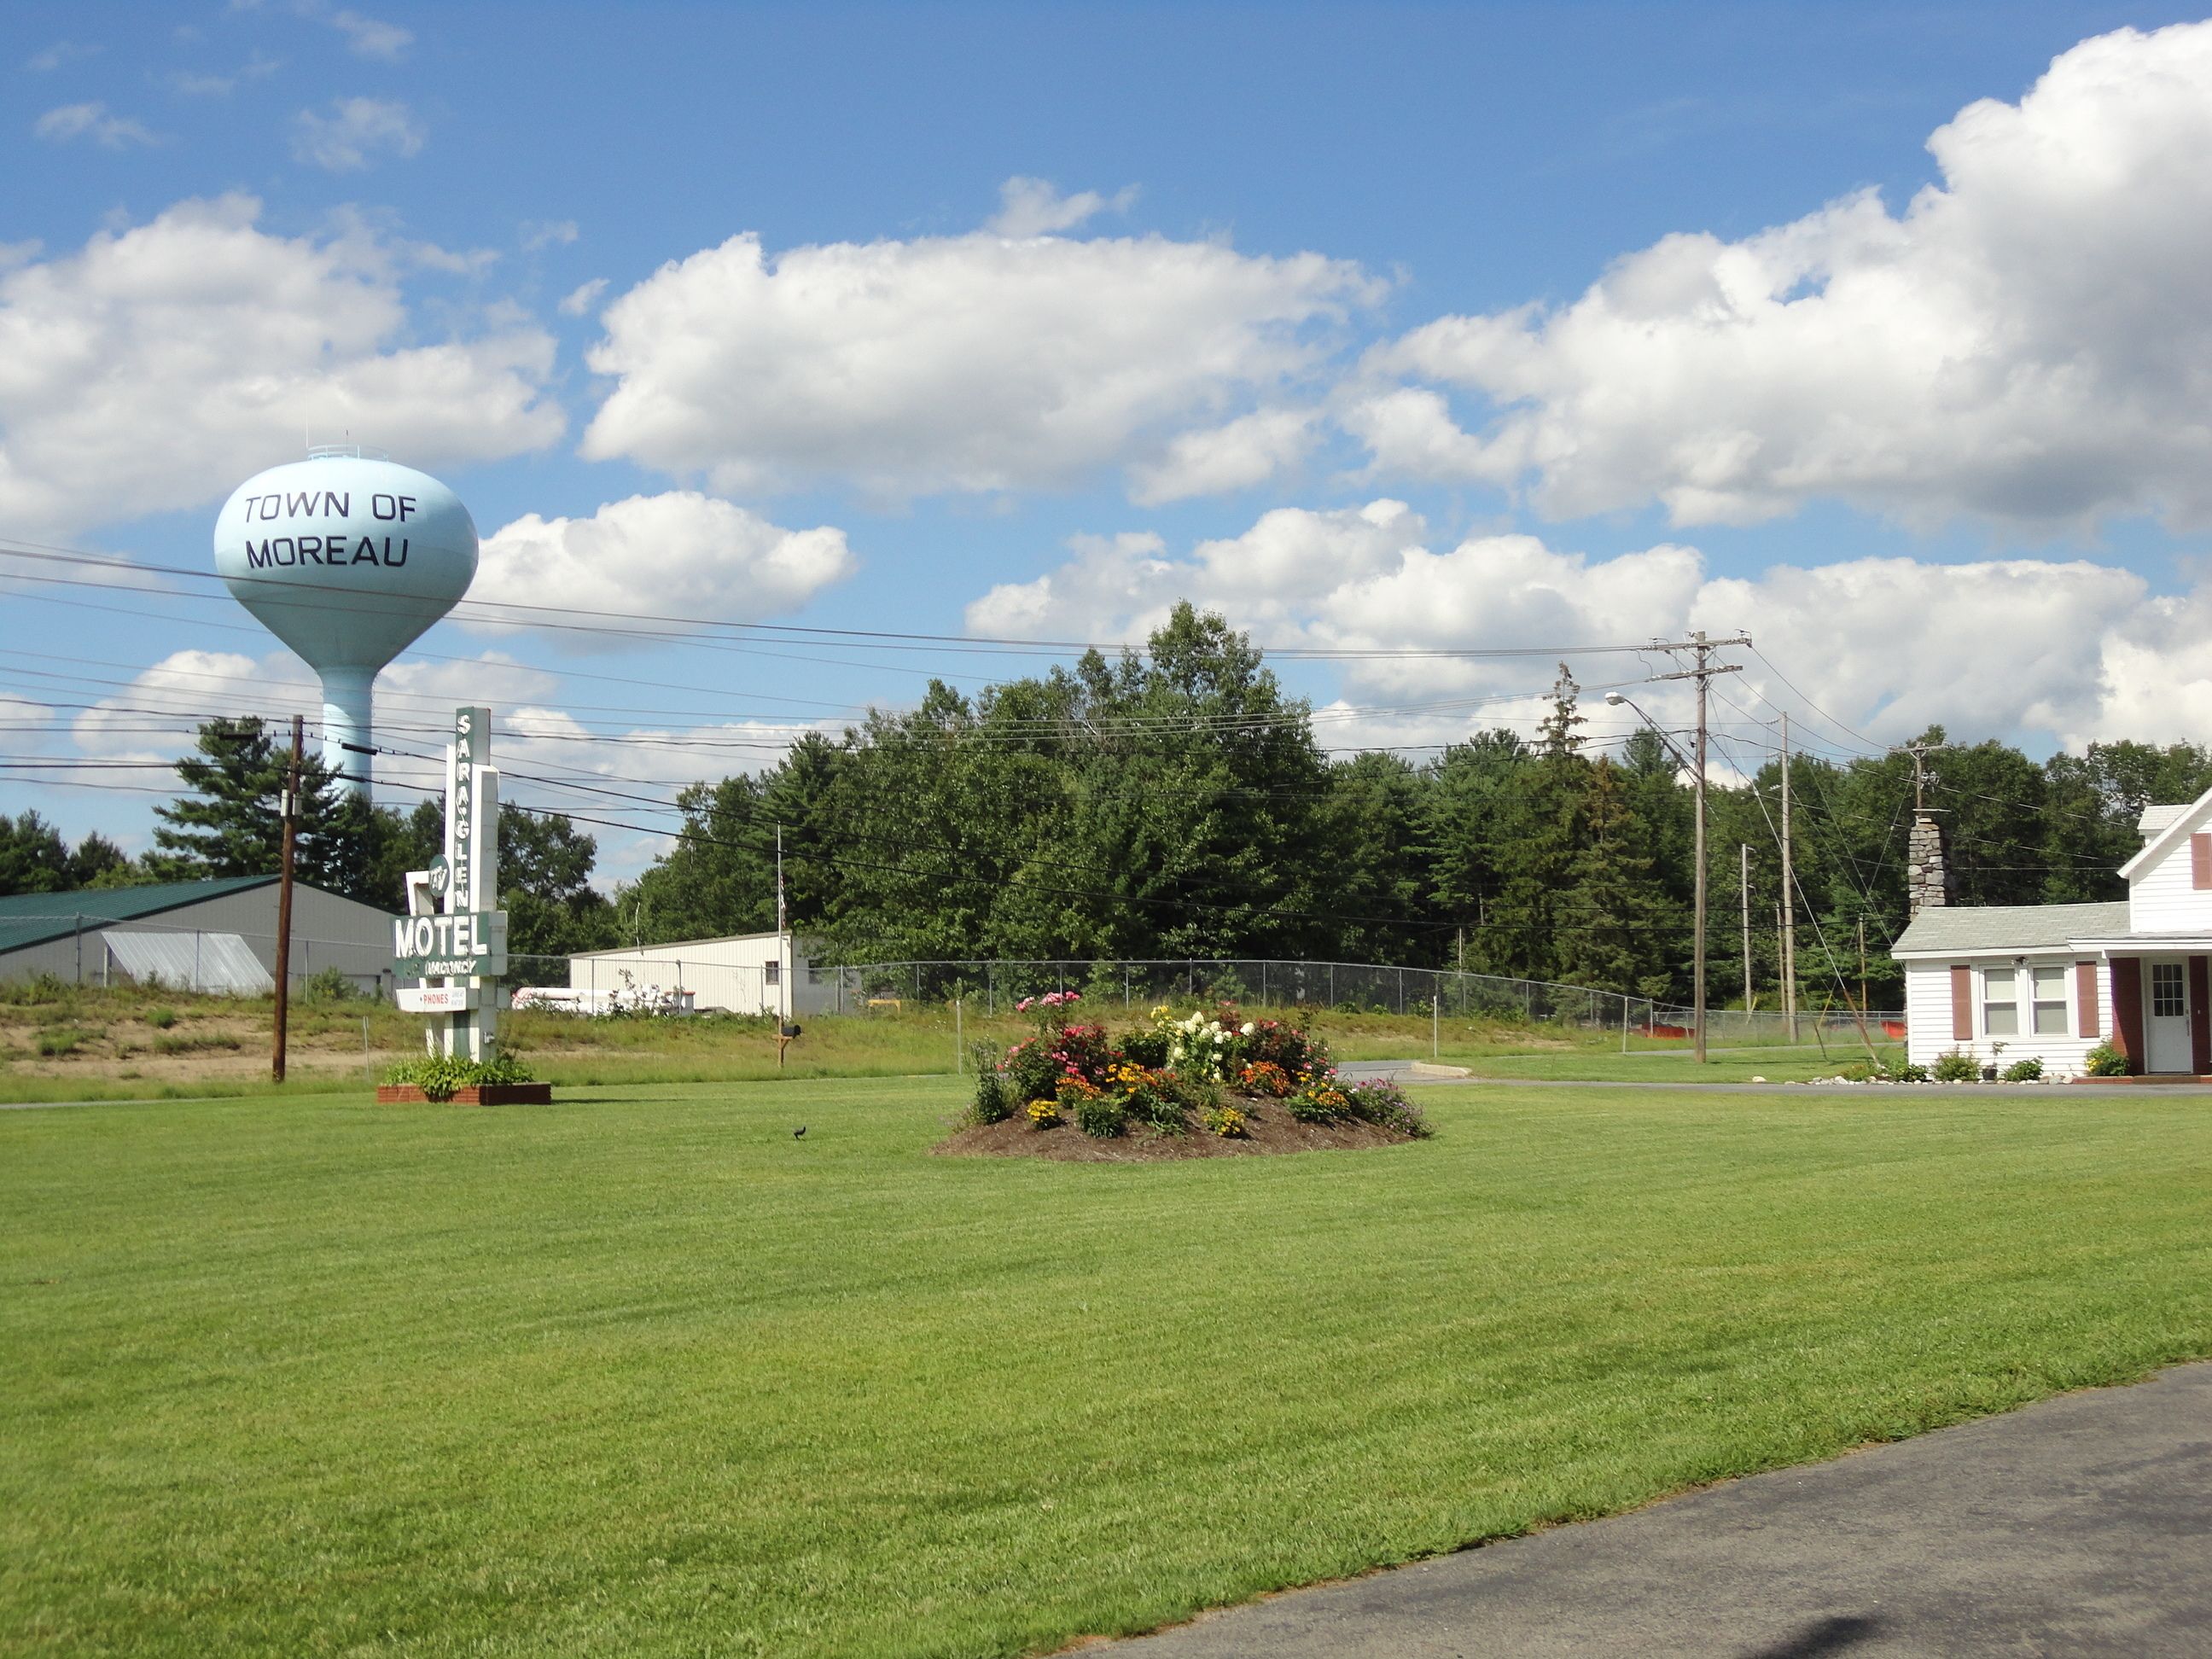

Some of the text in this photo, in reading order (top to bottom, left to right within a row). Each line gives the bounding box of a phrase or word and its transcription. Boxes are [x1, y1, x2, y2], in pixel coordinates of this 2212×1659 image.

[246, 491, 416, 523] TOWN OF
[246, 536, 409, 568] MOREAU
[395, 916, 487, 958] MOTEL
[423, 993, 449, 1004] PHONES
